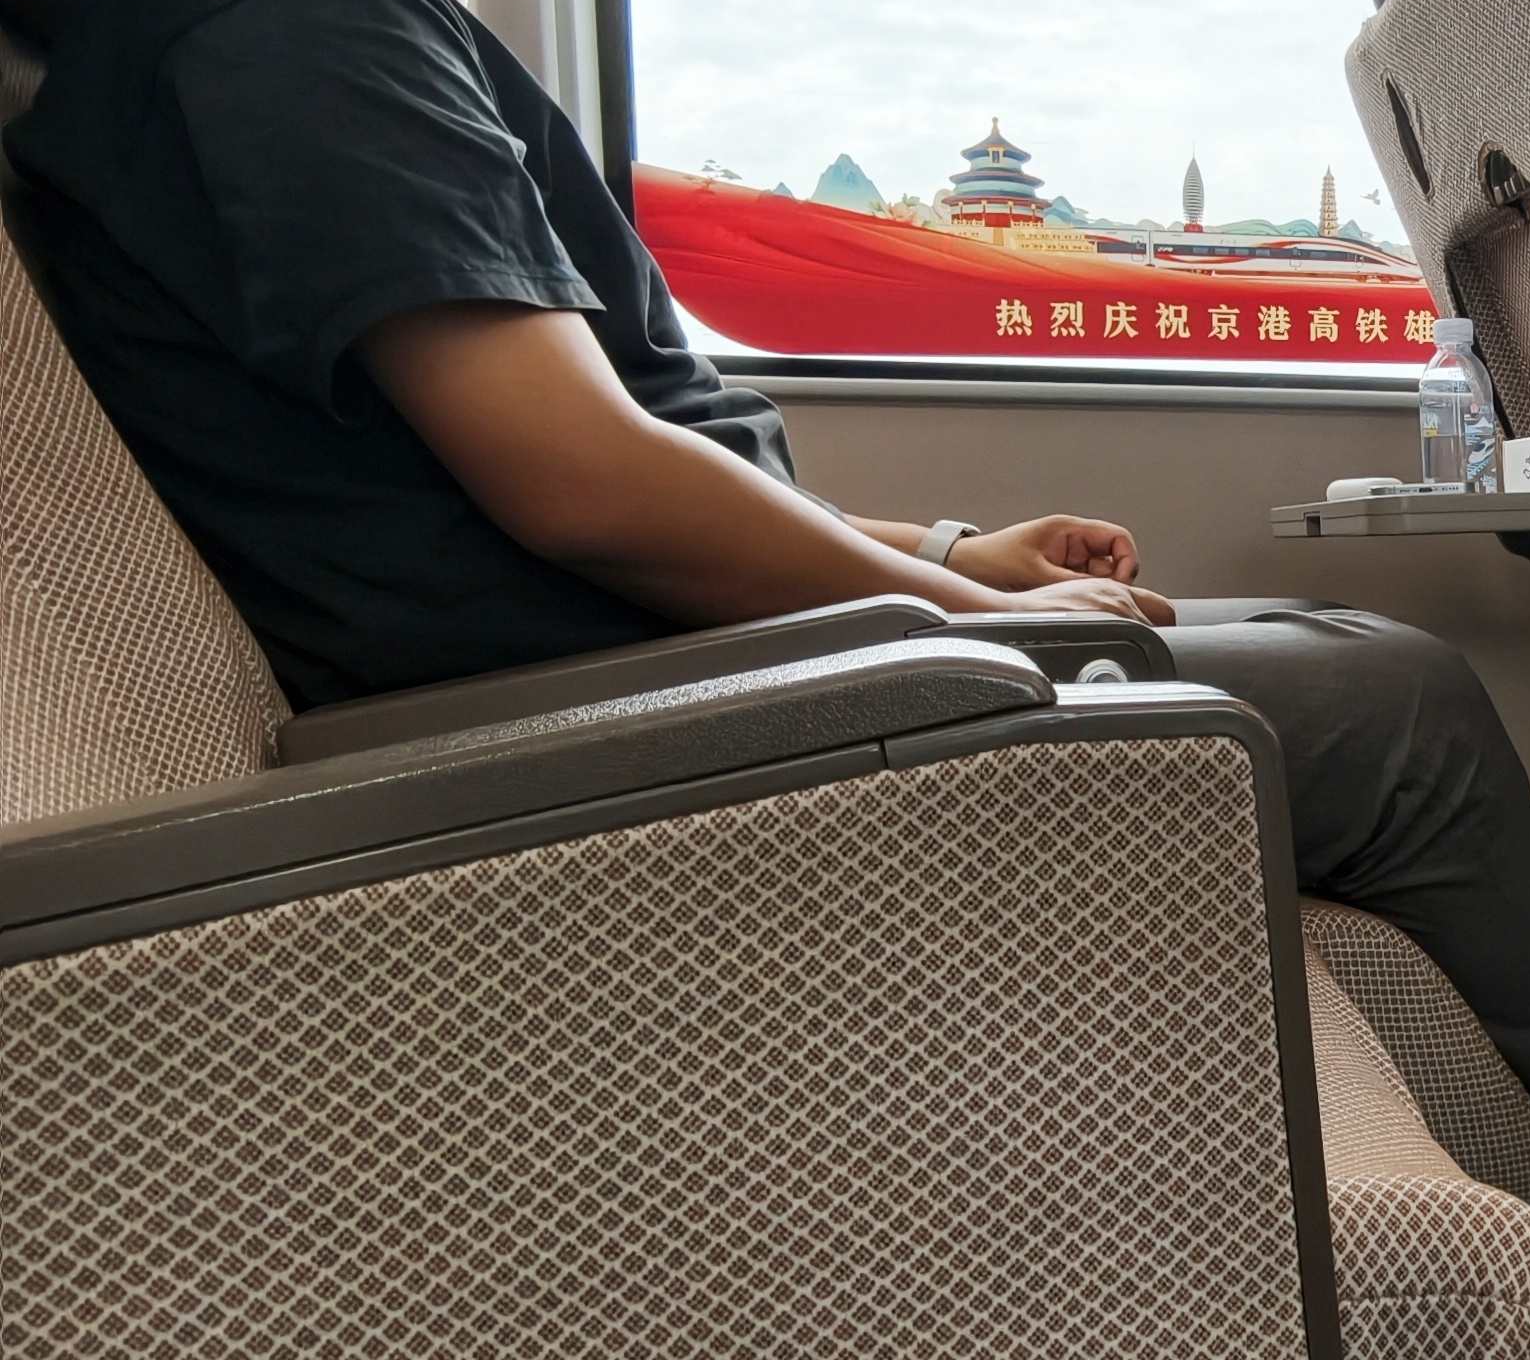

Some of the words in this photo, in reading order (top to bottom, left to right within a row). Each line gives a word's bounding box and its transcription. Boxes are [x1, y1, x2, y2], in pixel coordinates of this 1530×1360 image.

[995, 298, 1437, 345] 热烈庆祝京港高铁雄
